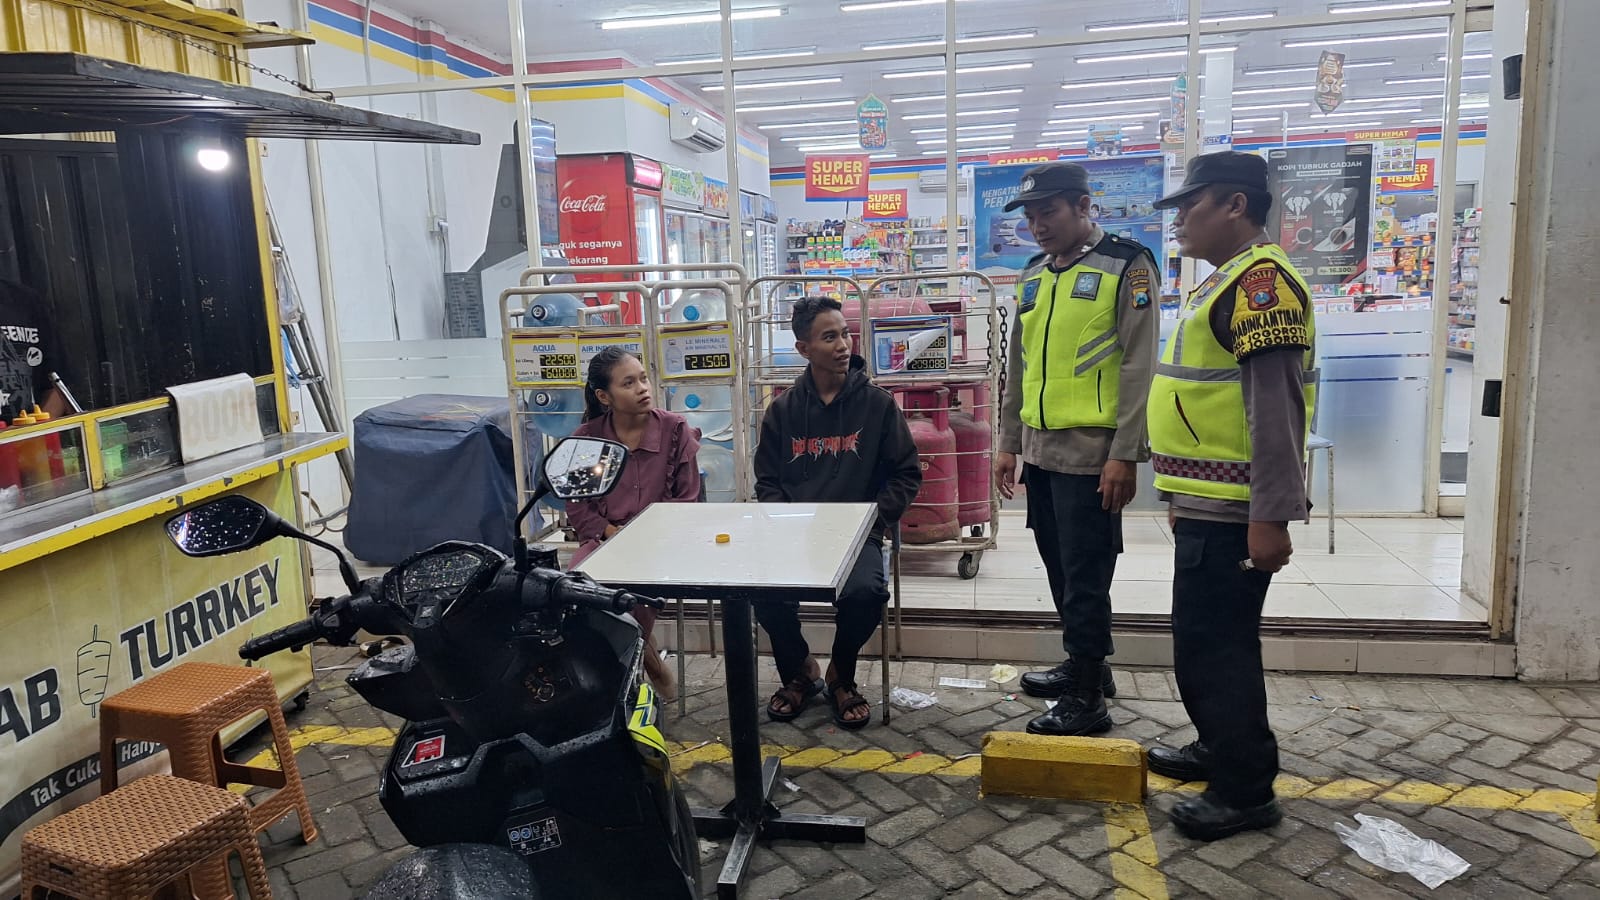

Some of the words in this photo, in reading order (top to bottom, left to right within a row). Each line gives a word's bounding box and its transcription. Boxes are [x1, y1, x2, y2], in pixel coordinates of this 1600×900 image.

[1354, 131, 1380, 139] SUPER
[812, 161, 863, 174] SUPER
[1278, 163, 1296, 171] KOPI
[1298, 162, 1329, 170] TUBRUK
[1330, 160, 1362, 169] GADJAH
[812, 173, 863, 187] HEMAT
[1387, 173, 1428, 183] HEMAT
[868, 193, 902, 202] SUPER
[579, 240, 622, 250] segarnya
[532, 344, 556, 352] AQUA
[120, 558, 280, 680] TURRKEY
[30, 778, 62, 807] Tak
